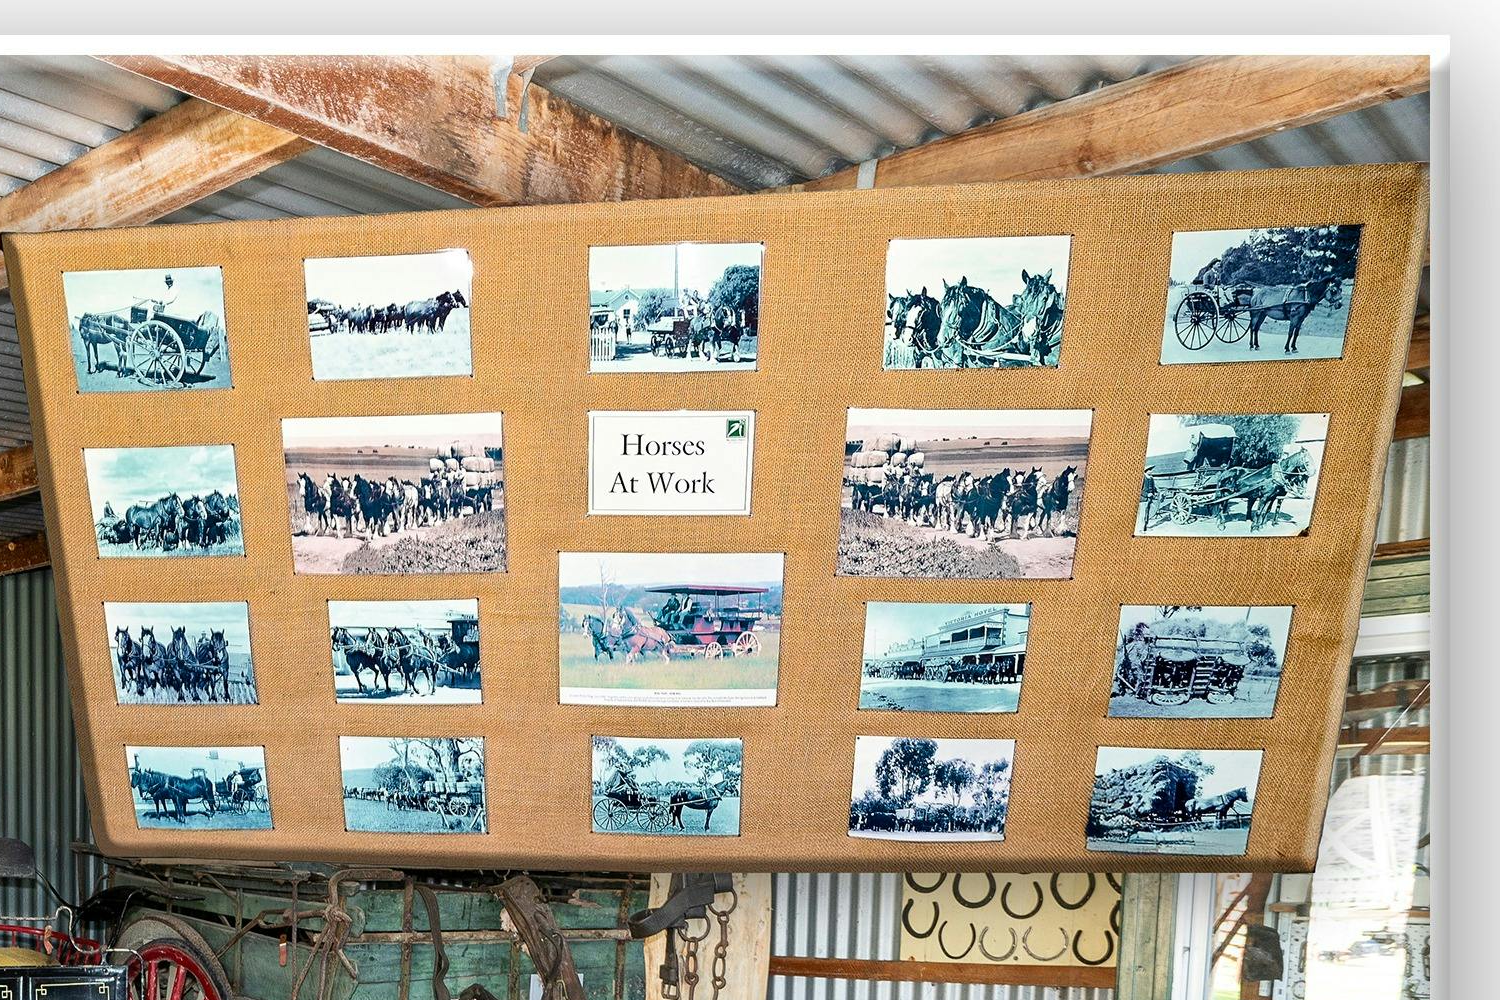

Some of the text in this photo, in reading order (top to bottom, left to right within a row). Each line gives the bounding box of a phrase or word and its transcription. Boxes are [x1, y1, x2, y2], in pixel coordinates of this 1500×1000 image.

[620, 432, 705, 456] Horses
[610, 471, 716, 495] At Work
